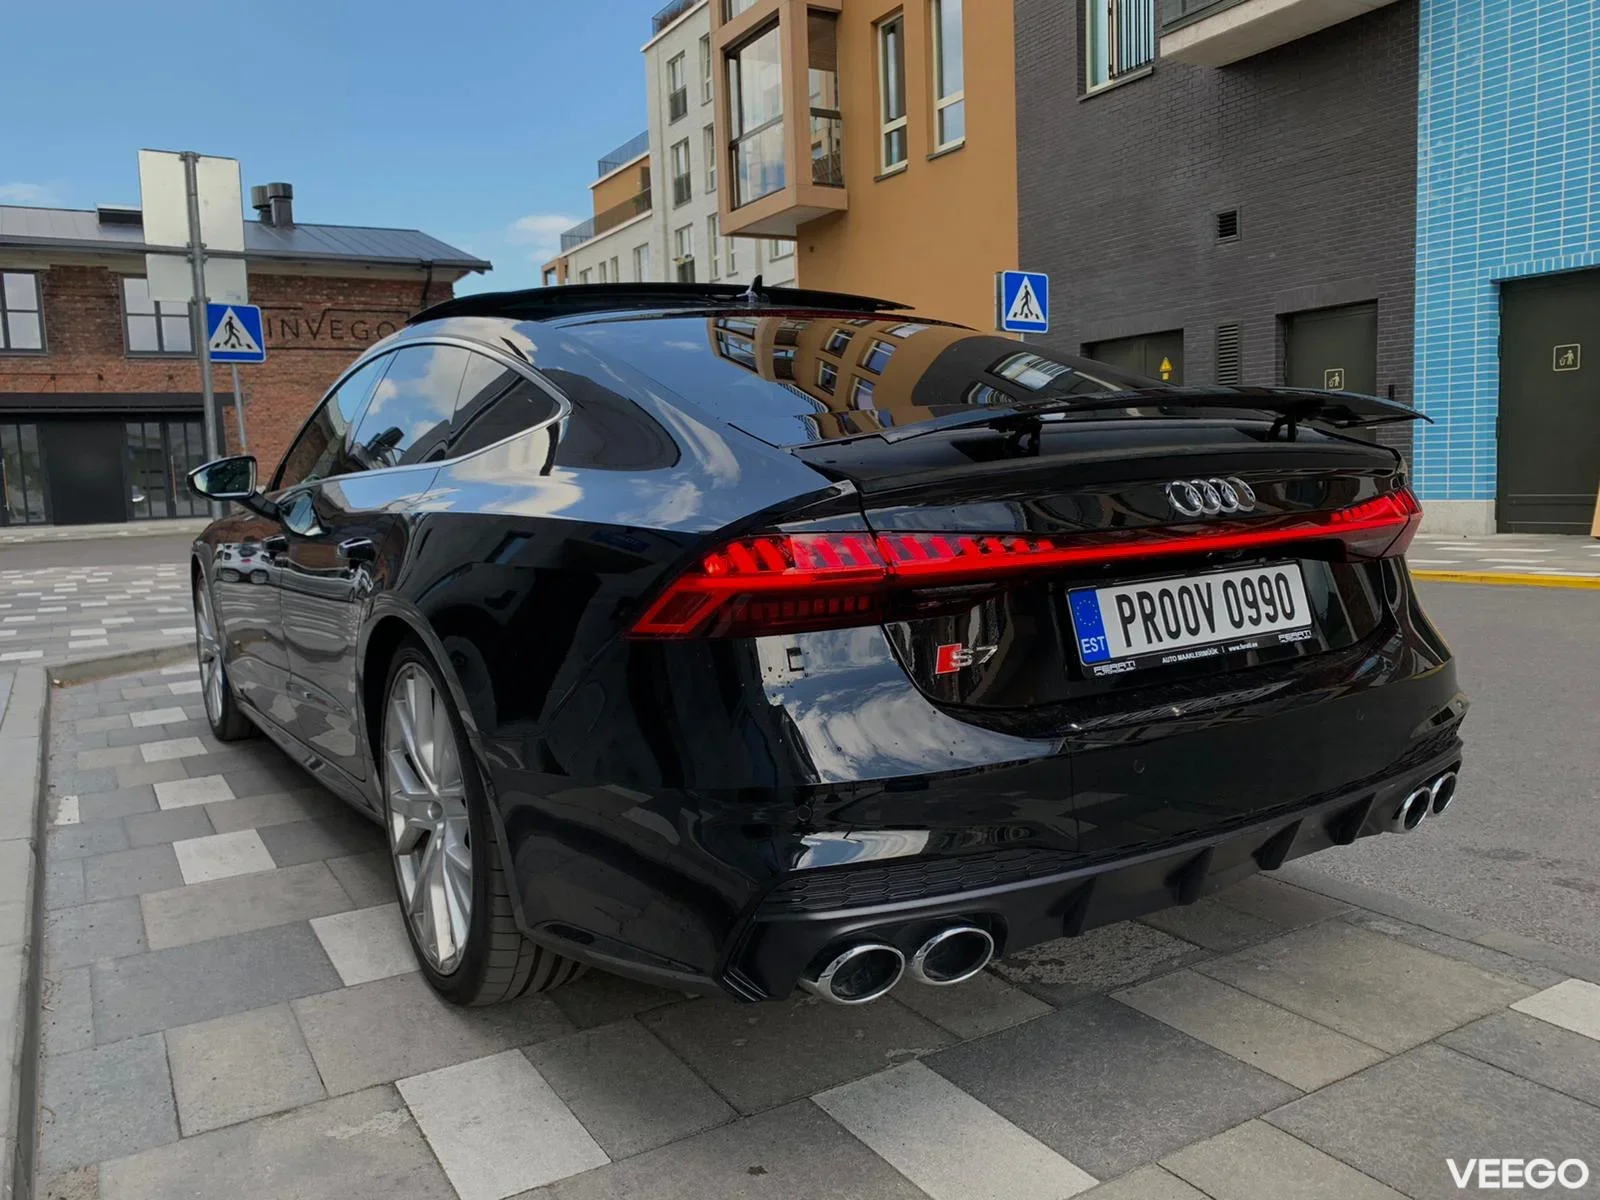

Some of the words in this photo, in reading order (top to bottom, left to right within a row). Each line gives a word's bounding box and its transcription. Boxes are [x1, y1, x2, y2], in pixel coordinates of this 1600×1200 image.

[267, 316, 397, 341] INVEGO
[1114, 582, 1216, 648] PROOV
[1222, 572, 1296, 629] 0990
[951, 645, 998, 668] S7
[1081, 635, 1106, 655] EST
[1162, 655, 1177, 664] AUTO
